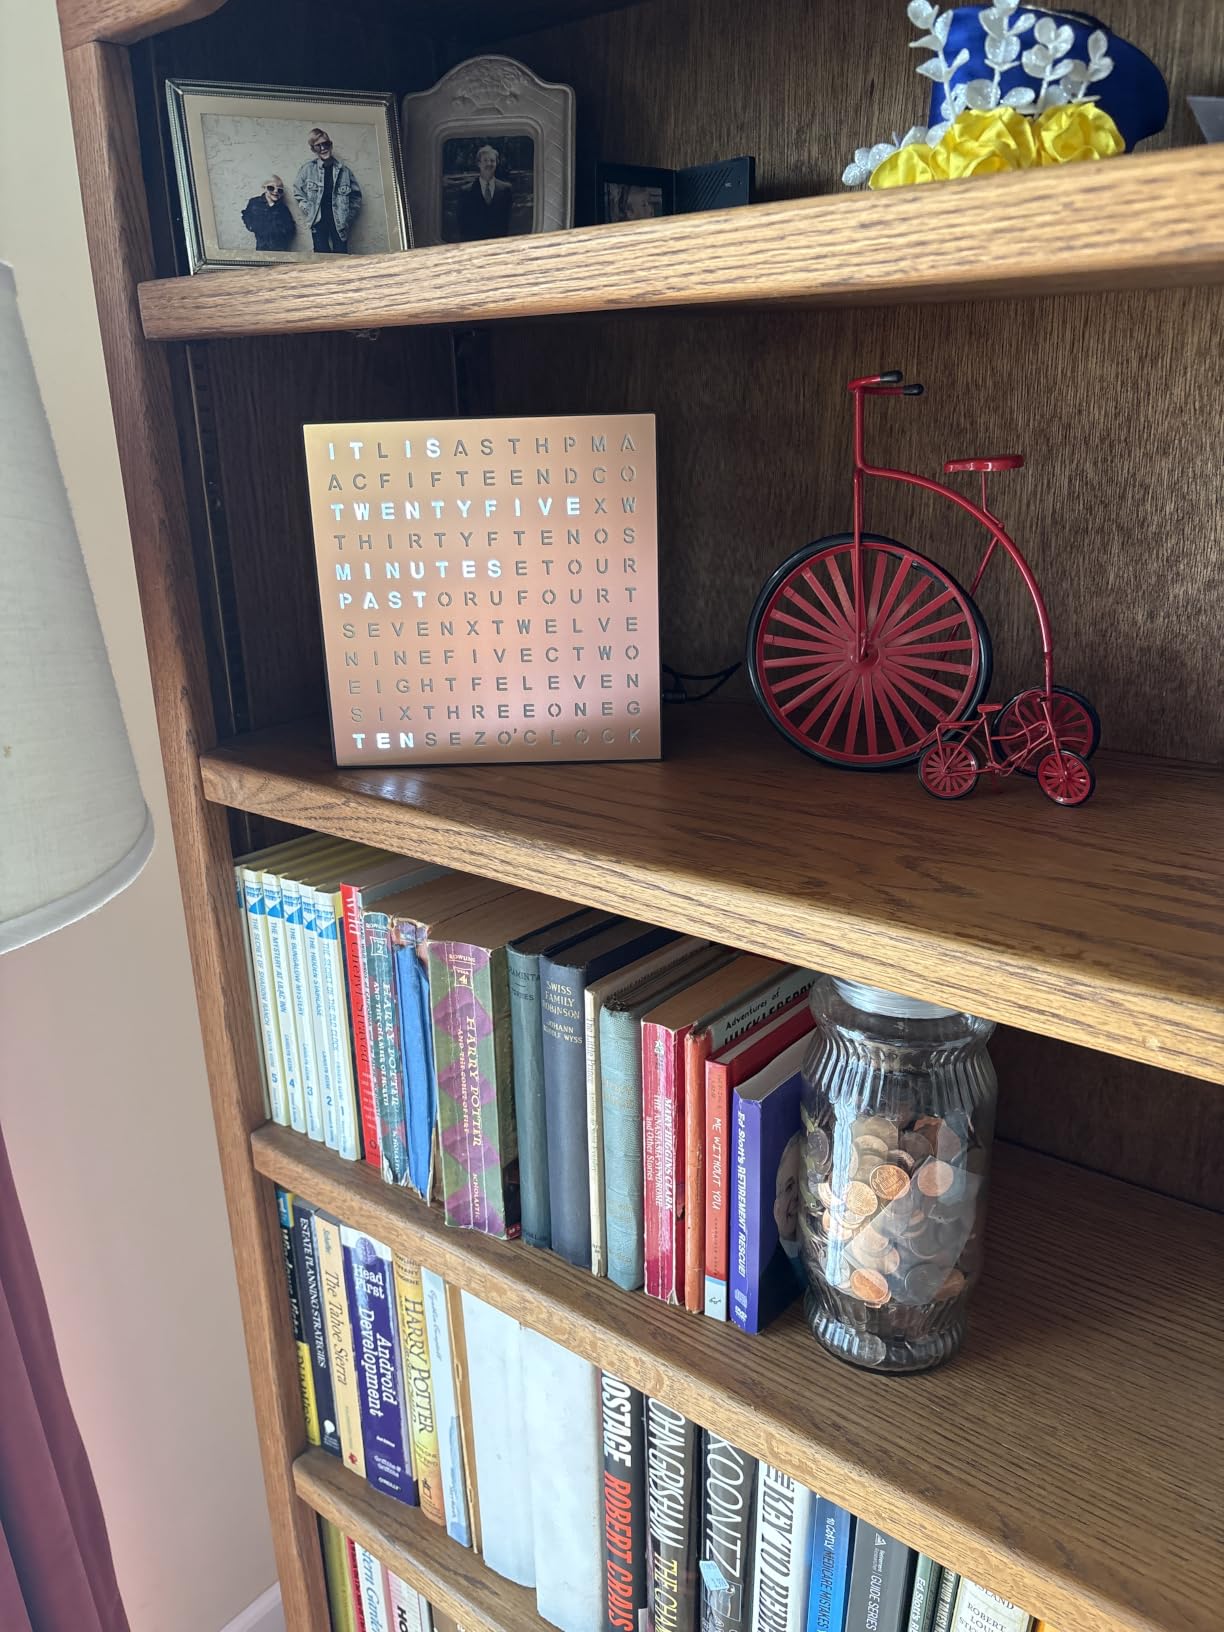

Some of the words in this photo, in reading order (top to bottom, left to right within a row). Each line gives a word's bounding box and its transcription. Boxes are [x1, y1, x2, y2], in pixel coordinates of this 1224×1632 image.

[344, 894, 359, 934] Wild
[459, 974, 468, 985] 4
[545, 991, 574, 1007] FAMILY
[546, 981, 572, 995] SWISS
[383, 983, 394, 1043] HARRY
[547, 1021, 574, 1034] JOHANN
[725, 1000, 768, 1031] Adventures
[771, 986, 780, 1000] of
[466, 1016, 479, 1079] HARRY
[564, 1034, 583, 1044] WYSS
[270, 1072, 278, 1083] 5
[288, 1078, 295, 1087] 4
[305, 1085, 314, 1096] 3
[387, 1048, 399, 1105] POTTER
[325, 1095, 332, 1105] 2
[470, 1085, 482, 1147] POTTER
[664, 1097, 674, 1124] MARY
[737, 1111, 745, 1128] Ed
[646, 1131, 654, 1151] Other
[712, 1117, 722, 1133] ME
[647, 1153, 655, 1180] Stories
[664, 1124, 674, 1172] HIGGINS
[711, 1136, 722, 1188] WITHOUT
[737, 1129, 746, 1165] Slott's
[655, 1160, 663, 1206] SYNDROME
[665, 1174, 675, 1210] CLARK
[711, 1190, 722, 1210] YOU
[737, 1166, 747, 1232] RETIREMENT
[299, 1217, 314, 1254] ESTATE
[738, 1231, 746, 1278] RESCUE!
[305, 1254, 320, 1309] PLANNING
[324, 1270, 341, 1303] The
[353, 1264, 384, 1287] Head
[310, 1308, 326, 1369] STRATEGIES
[327, 1298, 346, 1343] Tahoe
[404, 1297, 427, 1364] HARRY
[332, 1343, 349, 1391] Sierra
[359, 1307, 384, 1417] Development
[376, 1333, 398, 1405] Android
[411, 1365, 434, 1434] POTTER
[601, 1372, 632, 1468] OSTAGE
[648, 1397, 686, 1458] OHN
[604, 1470, 632, 1564] ROBERT
[649, 1447, 685, 1549] GRISHAM
[706, 1428, 744, 1578] KOONTZ
[762, 1478, 794, 1545] KEY
[654, 1552, 678, 1593] THE
[760, 1533, 791, 1578] TO
[819, 1546, 836, 1590] MEDICARE
[607, 1559, 634, 1632] CRAIS
[870, 1574, 883, 1602] GUIDE
[916, 1577, 926, 1592] Ed
[816, 1589, 832, 1630] MISTAKES
[865, 1600, 880, 1631] SERIES
[912, 1590, 924, 1621] Slott's
[968, 1602, 1007, 1631] ROBERT
